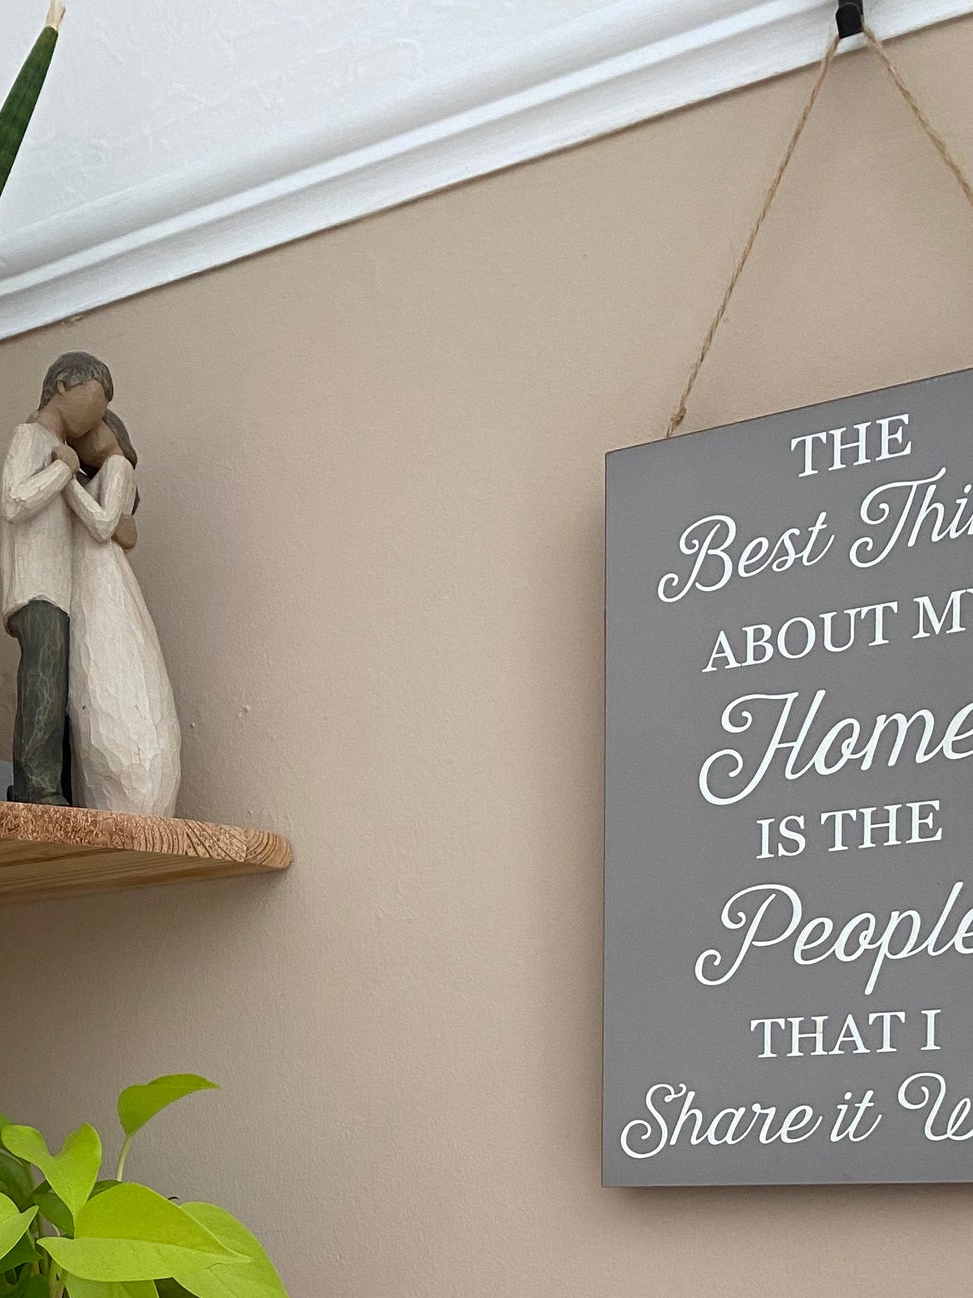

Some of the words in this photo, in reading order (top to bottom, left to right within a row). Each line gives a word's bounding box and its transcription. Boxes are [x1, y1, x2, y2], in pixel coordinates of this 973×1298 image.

[790, 413, 912, 478] THE
[657, 511, 835, 603] Best
[849, 467, 973, 568] Thi
[701, 601, 898, 673] ABOUT
[912, 588, 973, 640] M
[698, 689, 973, 806] Home
[755, 815, 806, 860] IS
[820, 799, 943, 852] THE
[750, 1011, 906, 1058] THAT
[920, 1009, 942, 1051] I
[620, 1083, 823, 1159] Share
[830, 1089, 883, 1143] it
